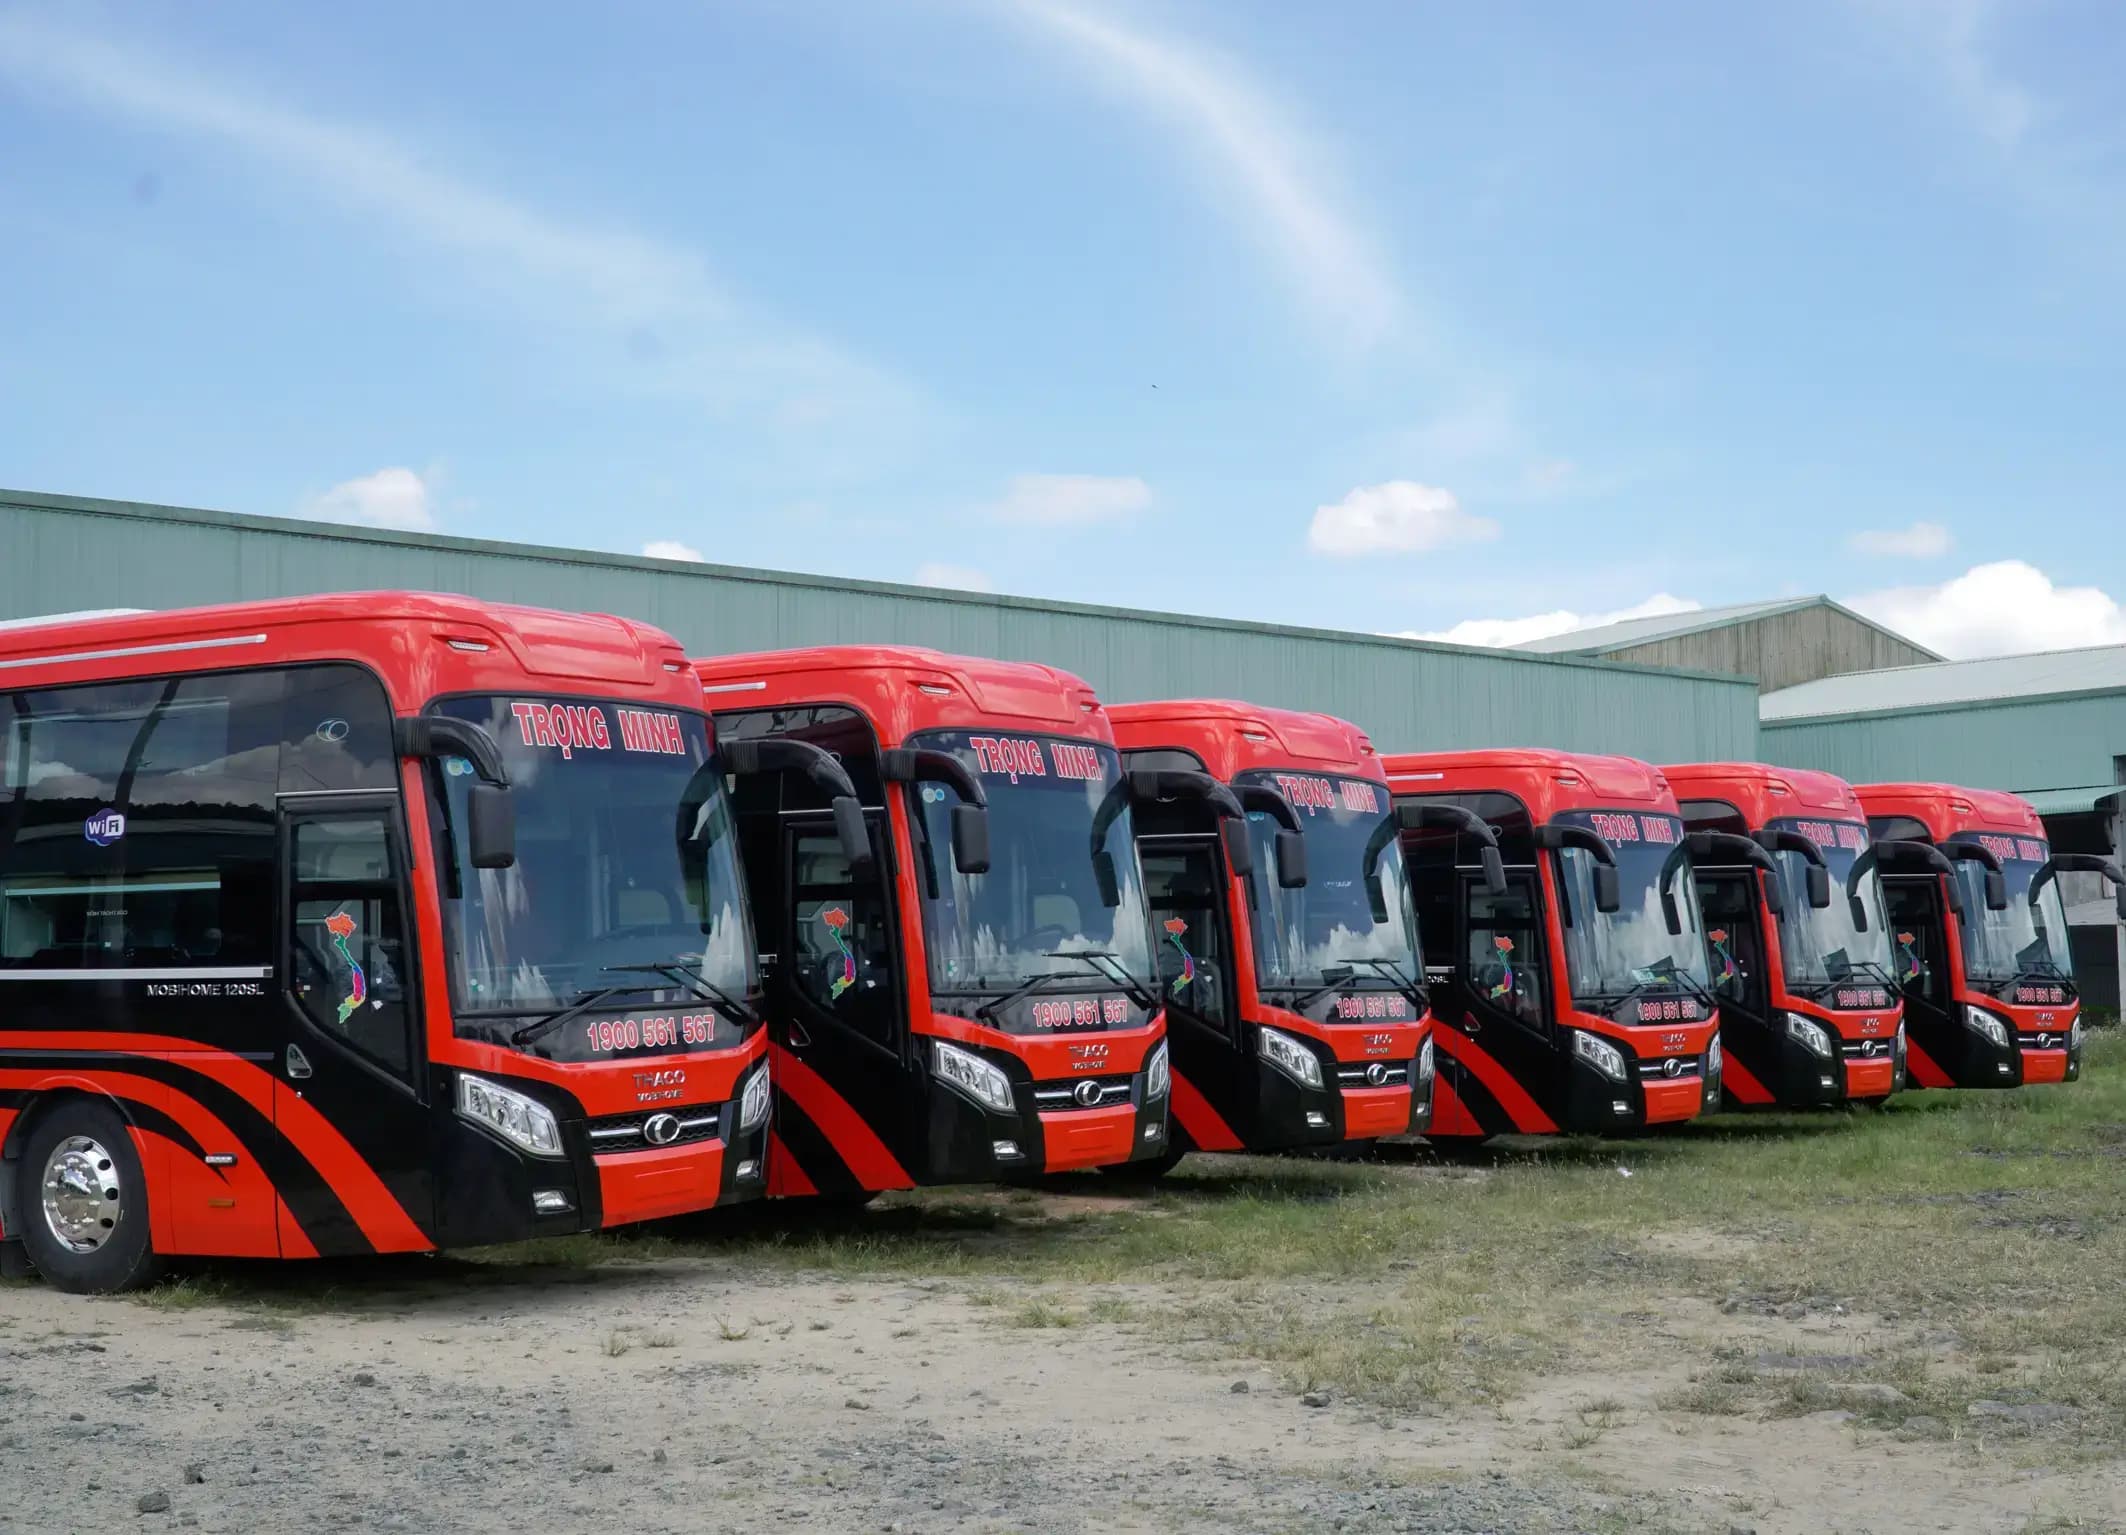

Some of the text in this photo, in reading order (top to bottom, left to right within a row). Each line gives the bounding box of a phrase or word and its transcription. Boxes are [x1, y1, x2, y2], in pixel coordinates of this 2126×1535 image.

[511, 703, 686, 759] TRỌNG MINH
[969, 737, 1103, 784] TRỌNG MINH
[1276, 776, 1379, 816] TRỌNG MINH
[88, 817, 123, 836] WiFi
[1590, 814, 1674, 848] TRỌNG MINH
[147, 984, 265, 997] MOBIHOME 120SL
[1033, 999, 1128, 1027] 1900 561 567
[1336, 997, 1365, 1018] 1900
[1366, 997, 1387, 1018] 561
[1638, 1002, 1662, 1020] 1900
[586, 1014, 715, 1052] 1900 561 567
[633, 1069, 686, 1087] THACO
